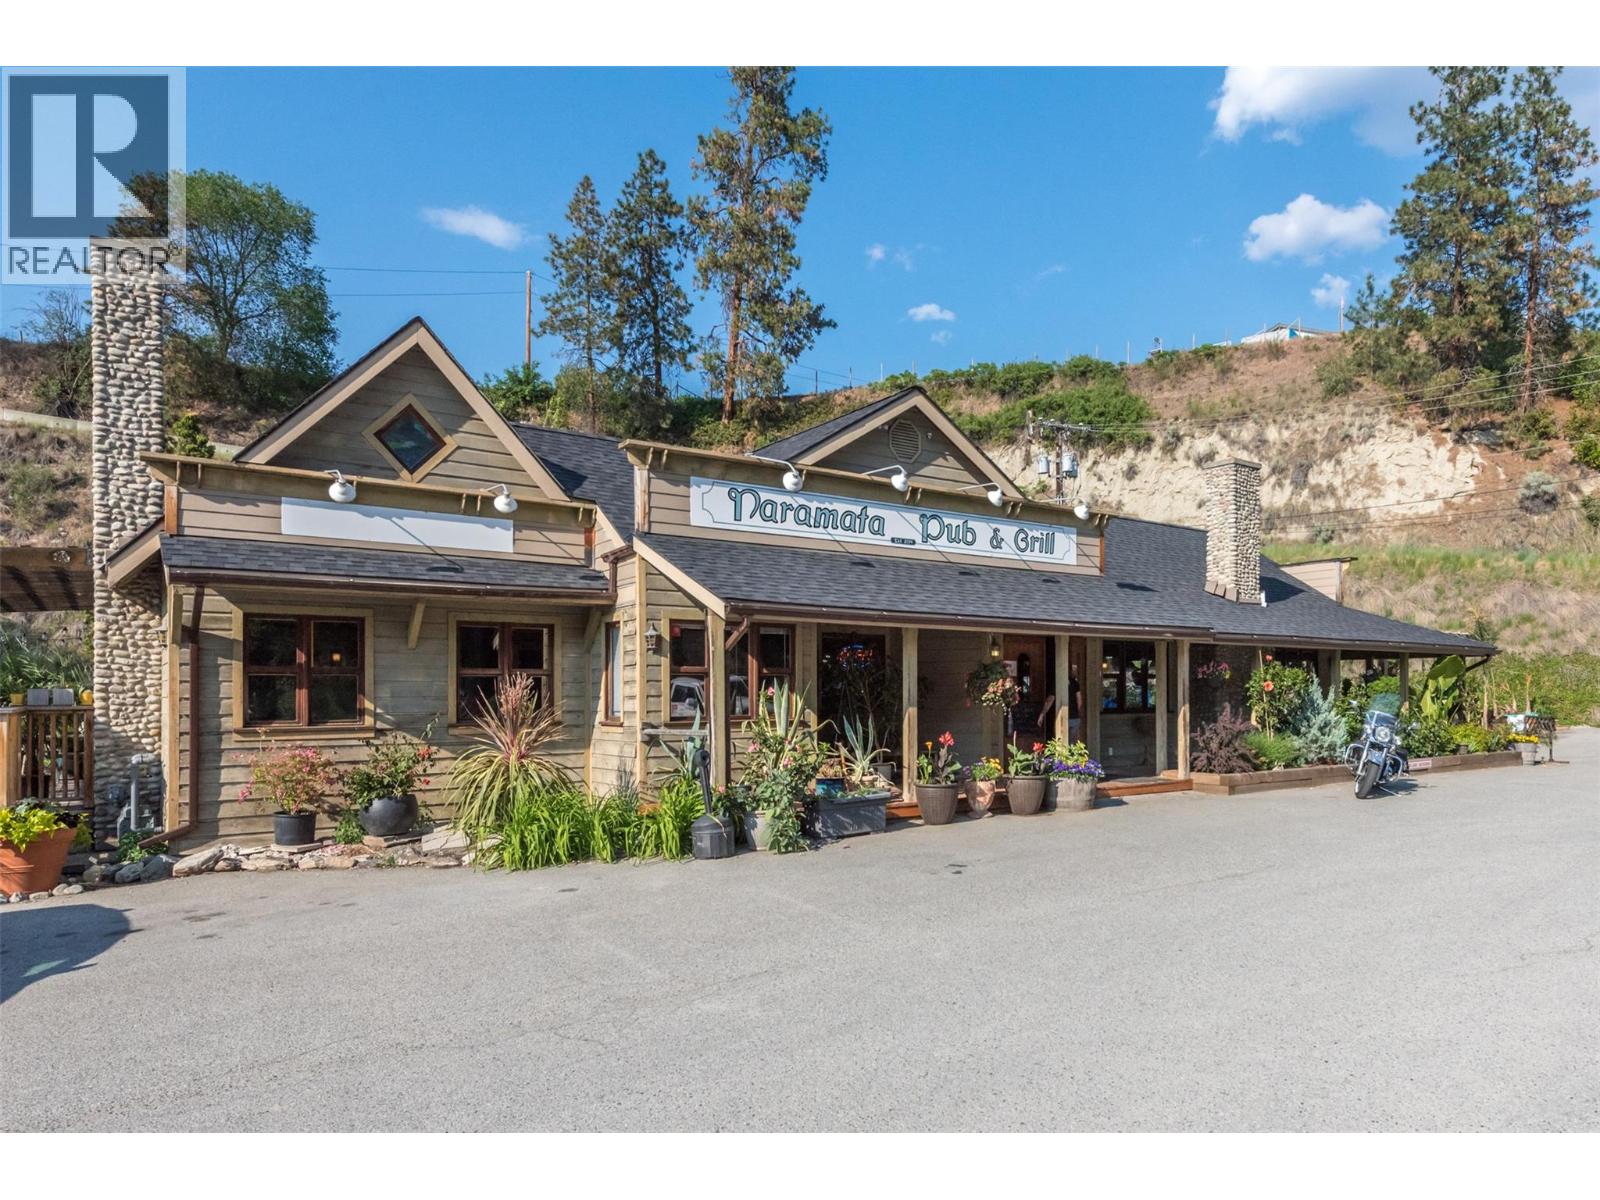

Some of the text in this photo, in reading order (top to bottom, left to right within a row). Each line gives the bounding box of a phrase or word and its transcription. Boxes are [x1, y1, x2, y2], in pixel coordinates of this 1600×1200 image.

[728, 487, 1056, 555] Naramata Pub & Grill
